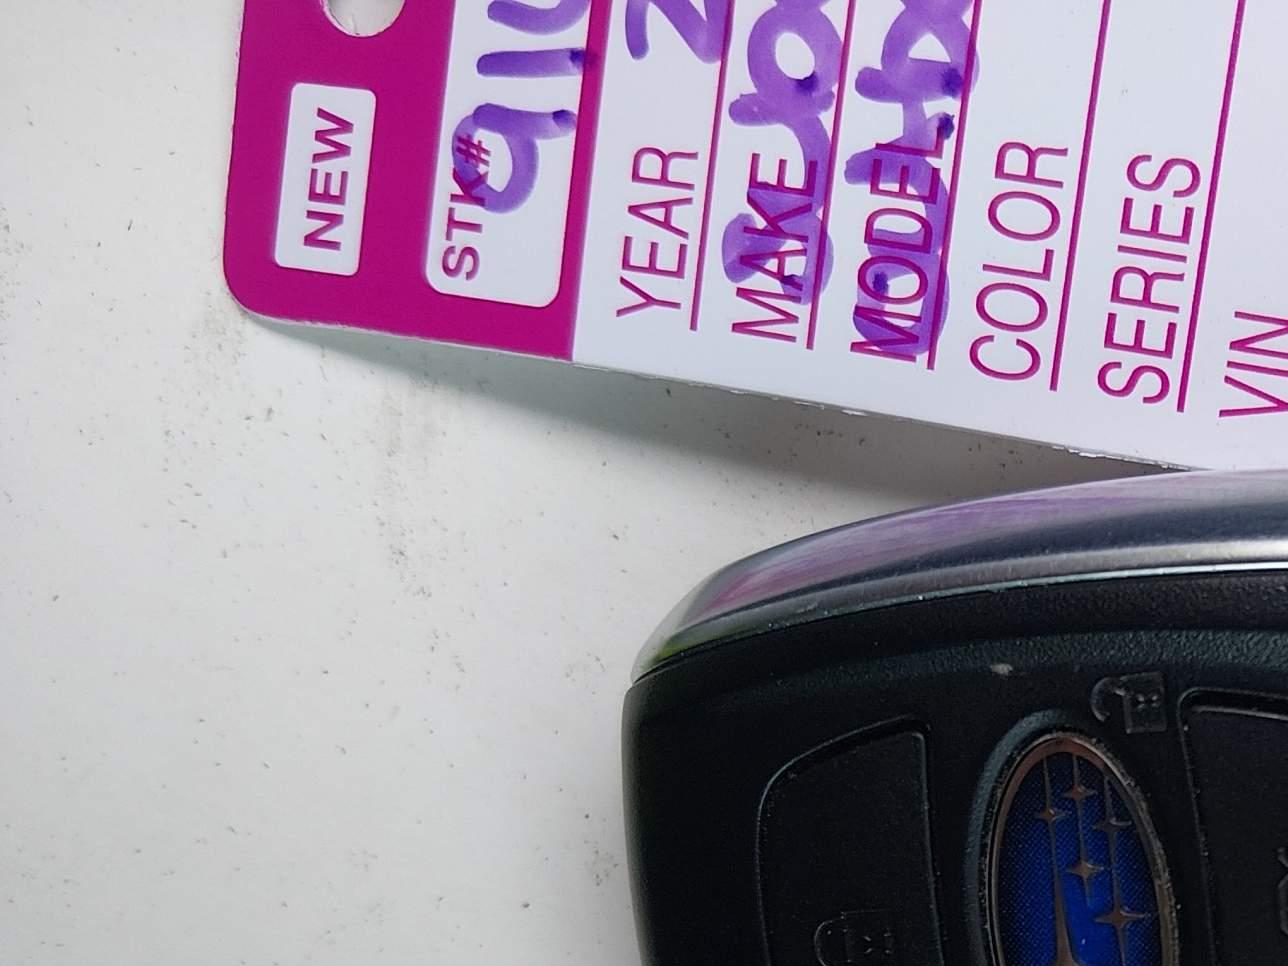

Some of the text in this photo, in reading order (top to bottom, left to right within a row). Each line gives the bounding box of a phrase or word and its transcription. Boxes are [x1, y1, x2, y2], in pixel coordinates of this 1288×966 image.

[303, 106, 355, 252] NEW
[441, 133, 492, 281] STK#
[616, 145, 700, 319] YEAR
[731, 152, 819, 343] MAKE
[849, 126, 946, 363] MODEL
[968, 141, 1069, 381] COLOR
[1097, 154, 1202, 405] SERIES
